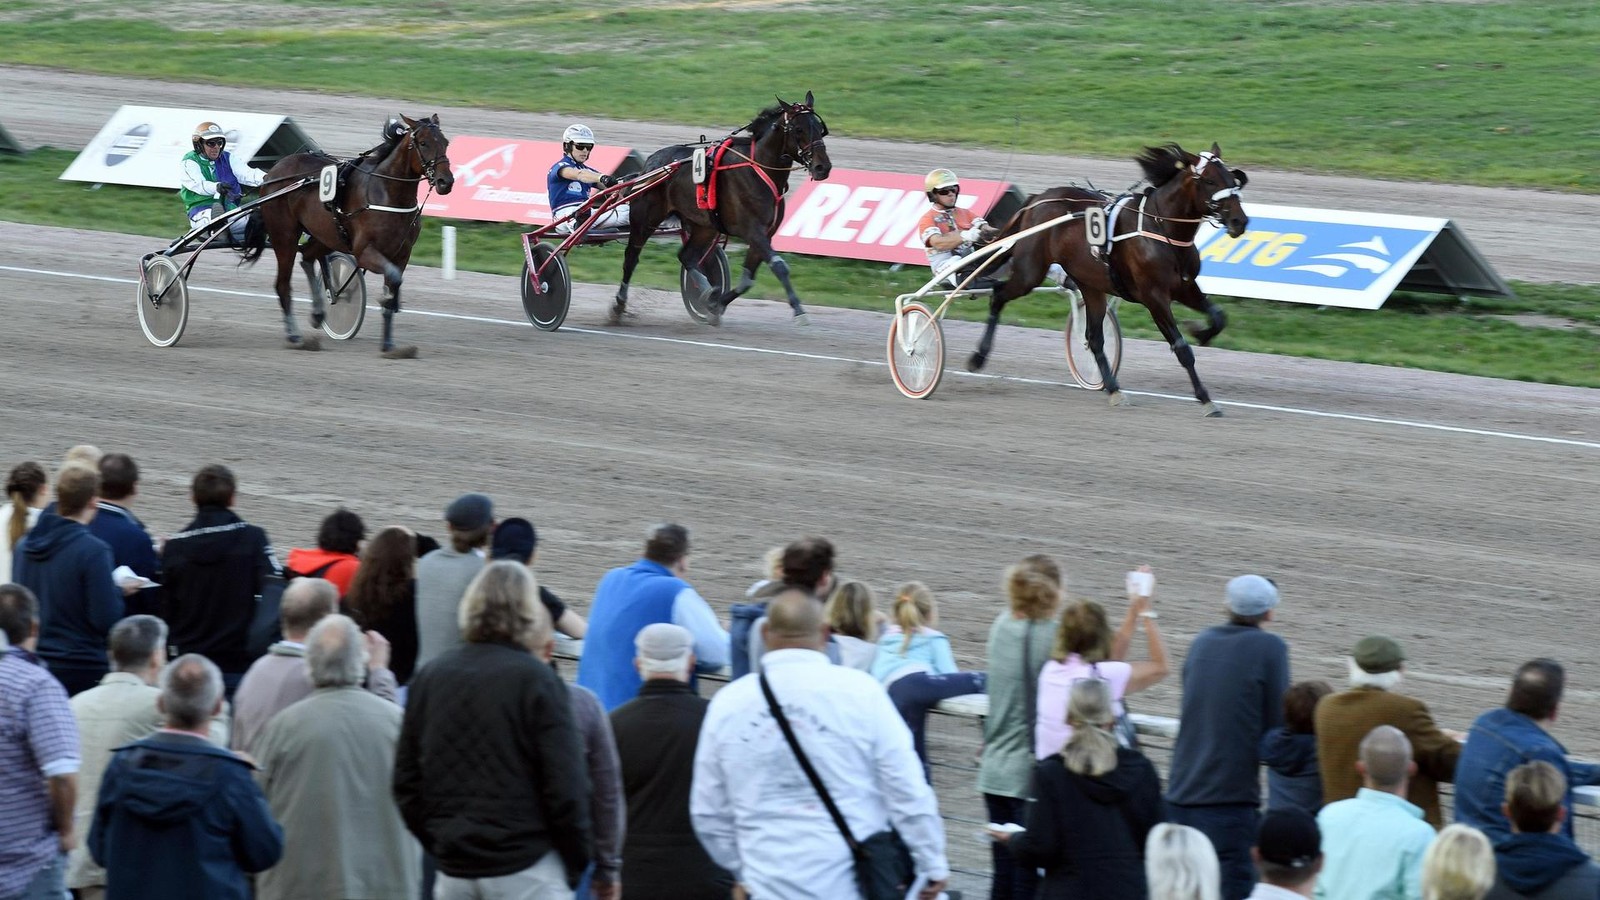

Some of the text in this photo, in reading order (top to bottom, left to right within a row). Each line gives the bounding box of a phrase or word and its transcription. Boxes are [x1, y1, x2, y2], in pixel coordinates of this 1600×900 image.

[694, 152, 702, 177] 4
[323, 170, 333, 196] 9
[1090, 211, 1101, 239] 6
[1198, 229, 1308, 267] ATG
